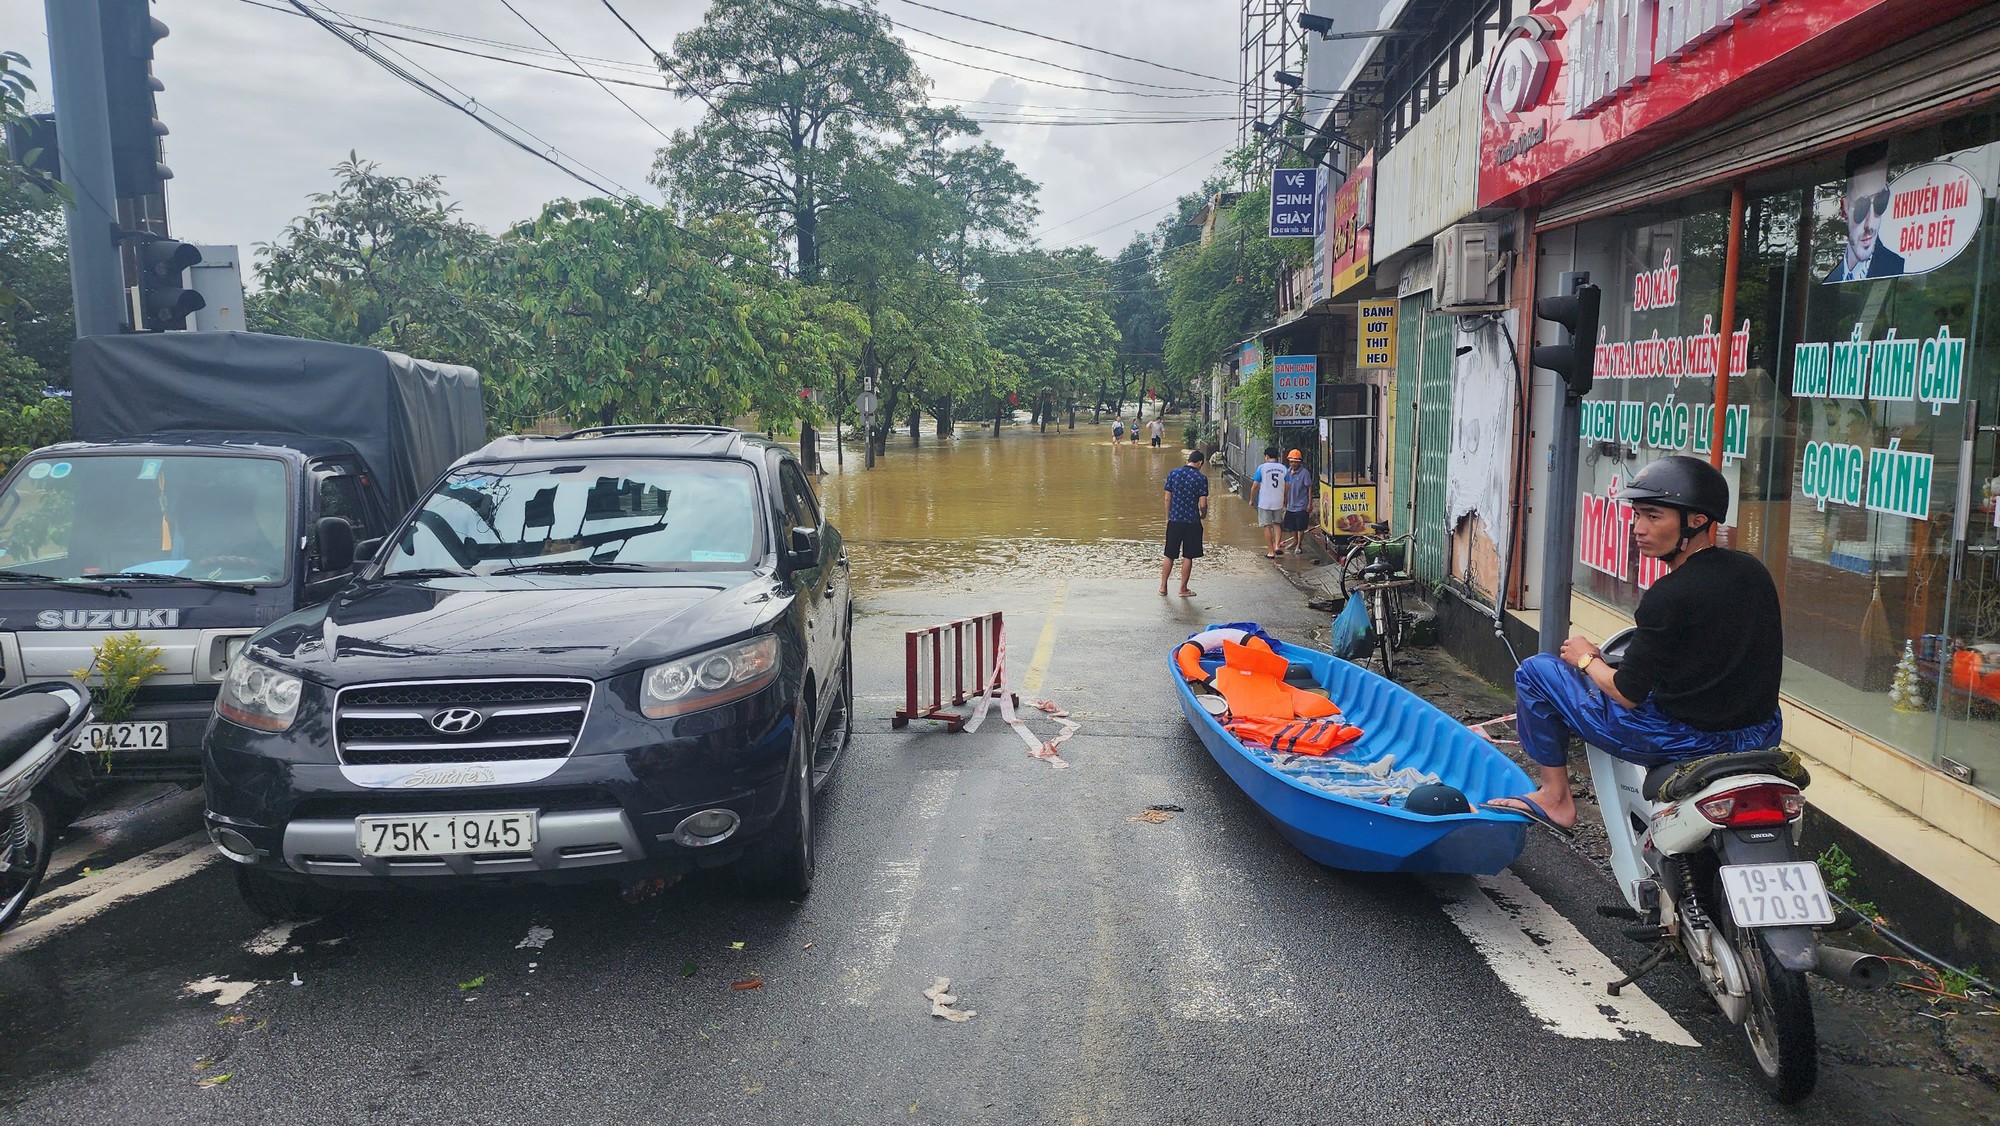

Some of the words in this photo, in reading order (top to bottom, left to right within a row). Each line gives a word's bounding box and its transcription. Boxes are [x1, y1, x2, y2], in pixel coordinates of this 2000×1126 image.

[1285, 172, 1305, 188] VỆ
[1276, 194, 1312, 205] SINH
[1893, 177, 1939, 219] KHUYẾN
[1942, 175, 1970, 211] MÃI
[1276, 211, 1311, 224] GIÀY
[1900, 221, 1924, 257] ĐẶC
[1926, 215, 1956, 253] BIỆT
[1634, 273, 1651, 310] ĐO
[1651, 248, 1678, 308] MẮT
[1363, 305, 1394, 317] BÁNH
[1367, 320, 1389, 332] ƯỚT
[1366, 338, 1389, 350] THỊT
[1366, 353, 1388, 363] HEO
[1593, 325, 1612, 379] IỂM
[1612, 341, 1632, 379] TRA
[1633, 328, 1665, 378] KHÚC
[1665, 336, 1684, 388] XẠ
[1685, 314, 1720, 377] MIỄN
[1729, 318, 1750, 376] HÍ
[1793, 343, 1829, 397] MUA
[1830, 323, 1871, 399] MẮT
[1869, 328, 1919, 400] KÍNH
[1919, 326, 1965, 415] CẬN
[1295, 391, 1312, 400] SEN
[1580, 401, 1616, 447] DỊCH
[1620, 401, 1644, 454] VỤ
[1647, 394, 1688, 450] CÁC
[1271, 473, 1279, 488] 5
[1803, 441, 1863, 511] GỌNG
[1866, 438, 1933, 519] KÍNH
[1580, 474, 1634, 582] MẮT
[35, 609, 179, 629] SUZUKI
[371, 818, 520, 852] 75K-1945
[1739, 866, 1808, 894] 19-K1
[1738, 893, 1827, 922] 170.91
